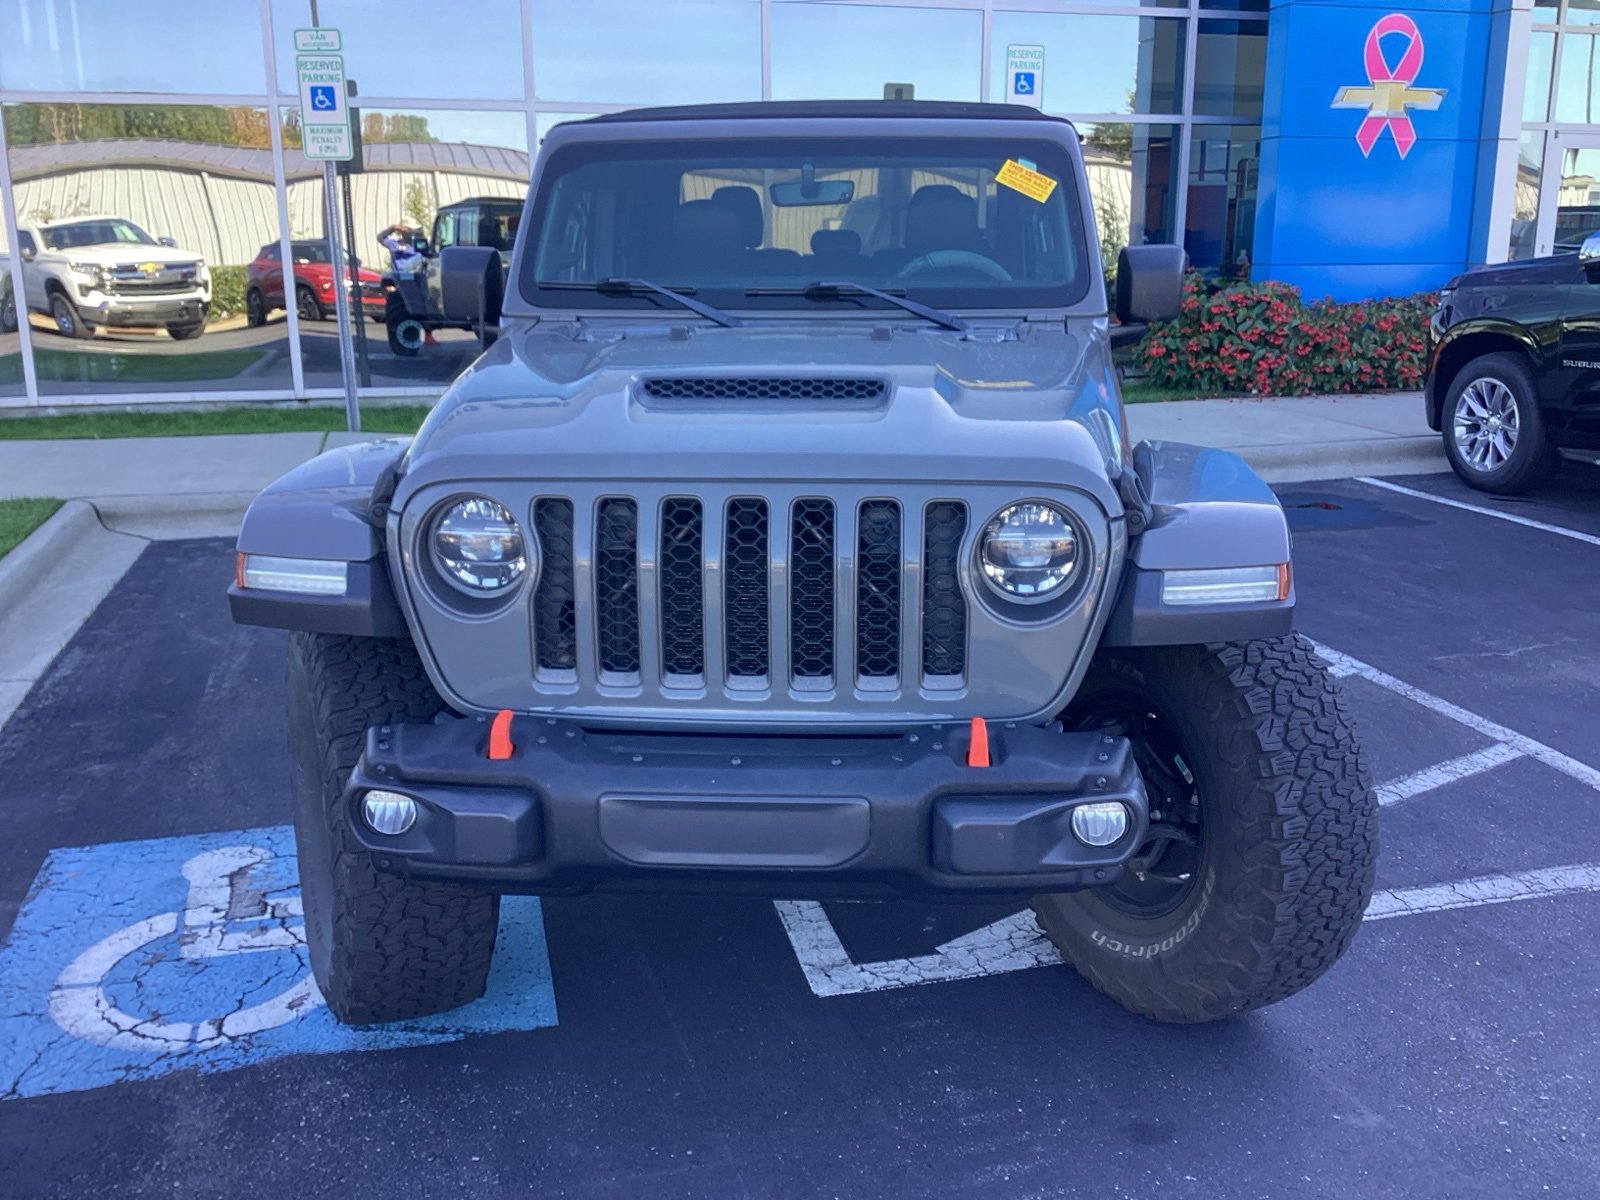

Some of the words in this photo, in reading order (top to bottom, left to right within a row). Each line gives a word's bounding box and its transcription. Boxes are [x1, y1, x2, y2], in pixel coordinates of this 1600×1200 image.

[1008, 50, 1043, 59] RESERVED
[299, 61, 341, 71] RESERVED
[1010, 60, 1041, 70] PARKING
[302, 73, 341, 82] PARKING
[1023, 169, 1054, 187] VEHICLE
[1032, 180, 1049, 191] SALE
